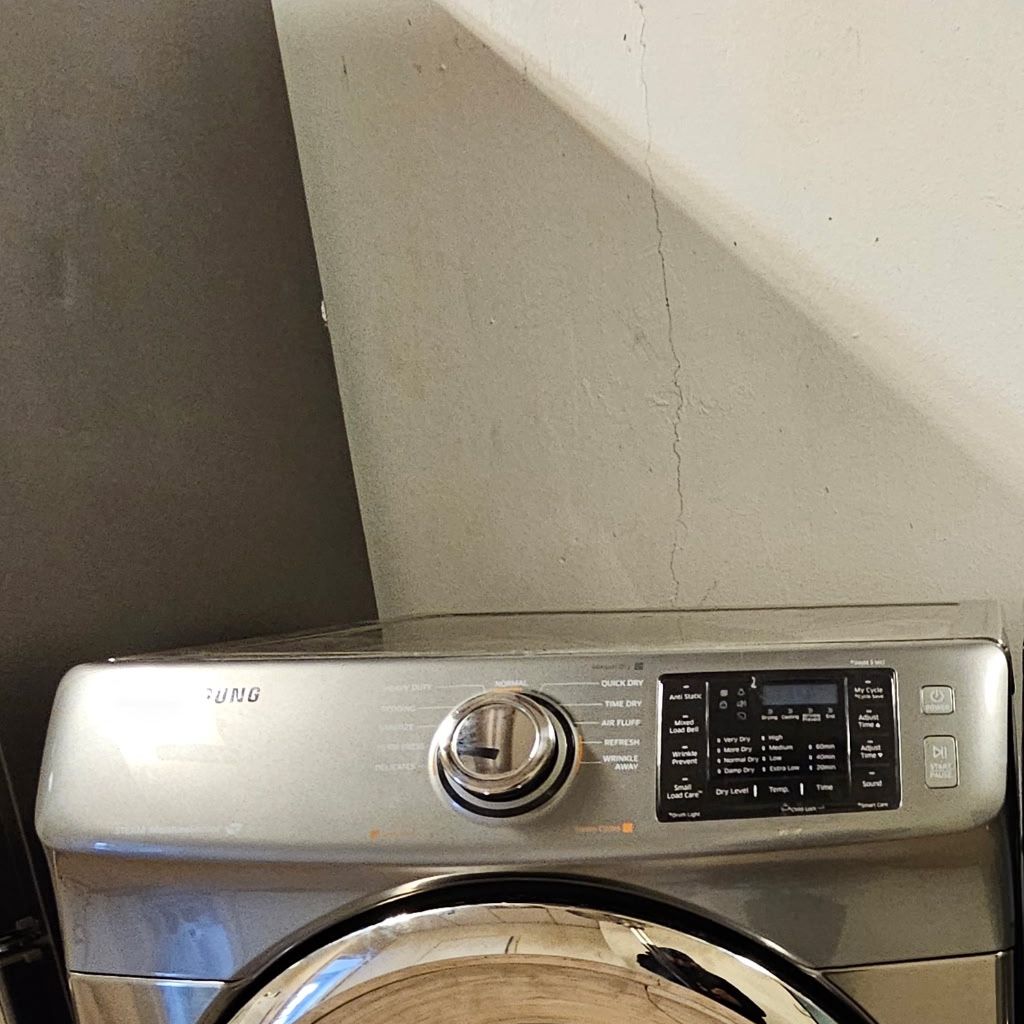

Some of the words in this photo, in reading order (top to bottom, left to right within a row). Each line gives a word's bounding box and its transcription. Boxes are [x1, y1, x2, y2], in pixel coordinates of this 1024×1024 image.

[605, 700, 624, 708] TIME
[860, 744, 881, 752] Adjust
[715, 788, 729, 796] Dry
[730, 787, 749, 795] Level
